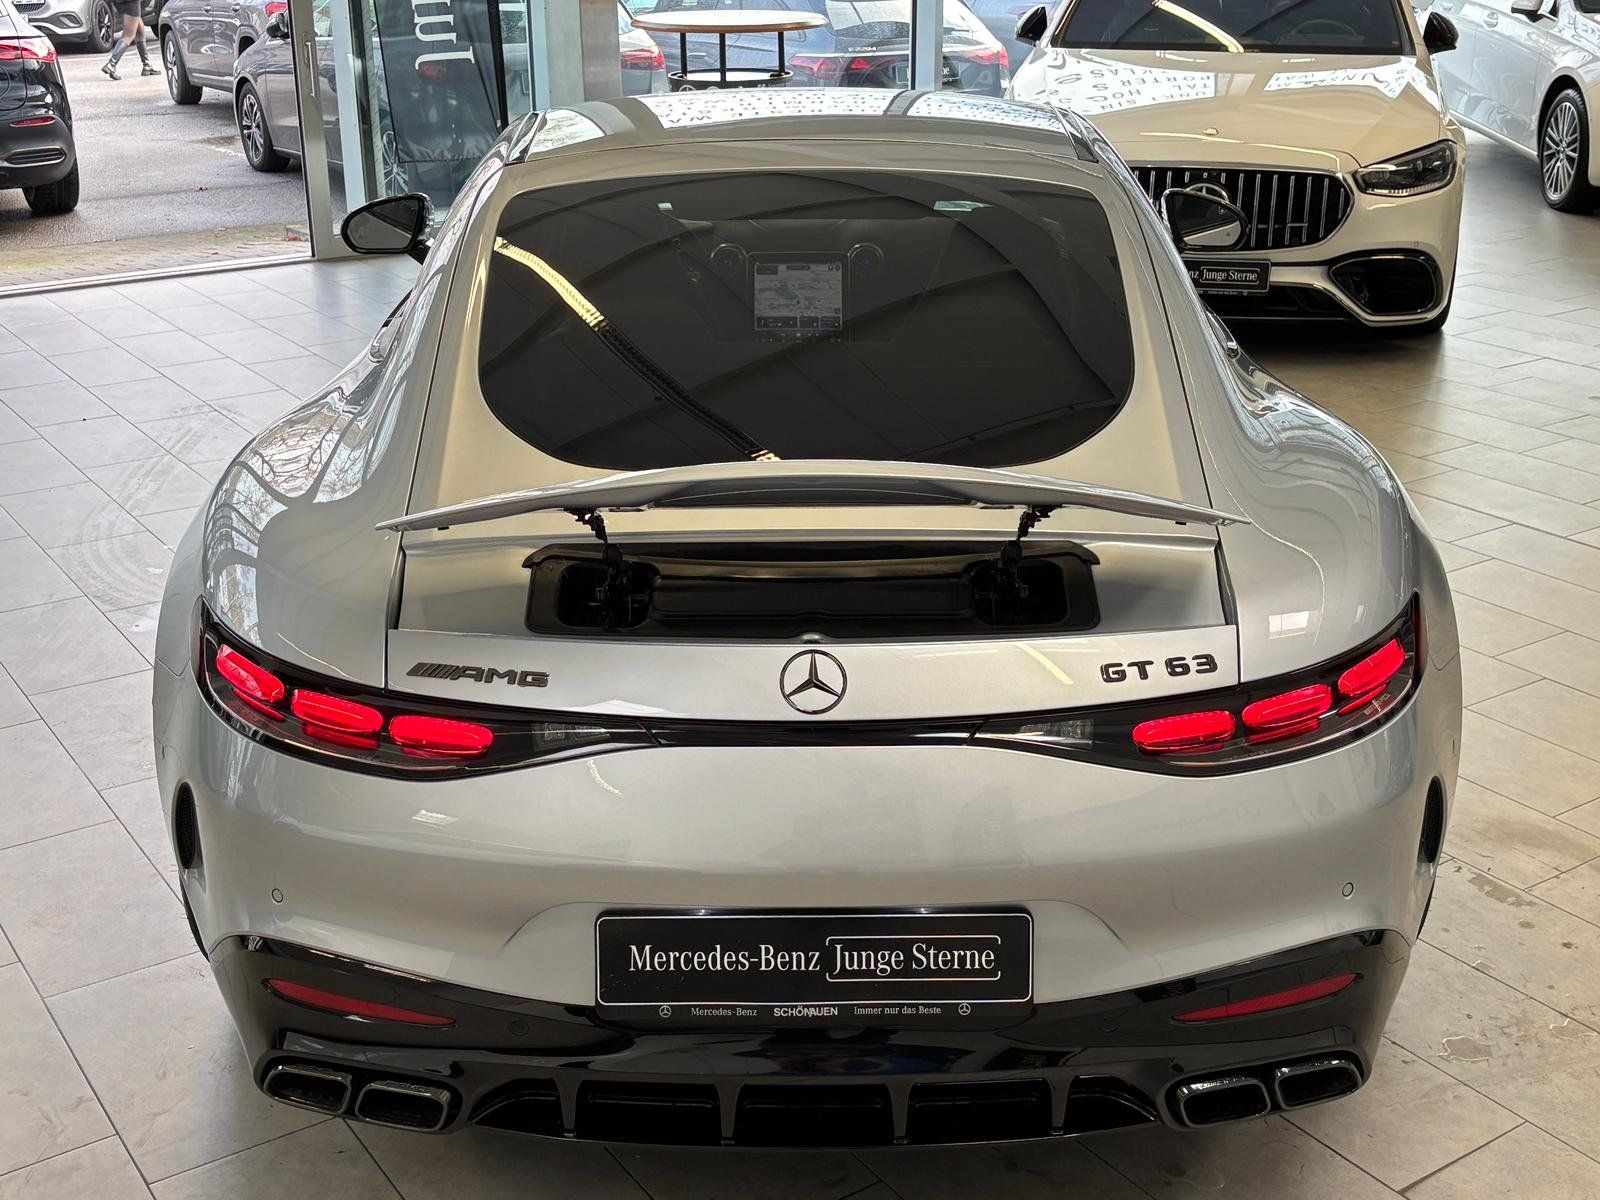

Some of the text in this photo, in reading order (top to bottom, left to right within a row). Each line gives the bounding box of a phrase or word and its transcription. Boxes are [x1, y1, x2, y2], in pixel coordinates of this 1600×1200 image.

[1202, 268, 1227, 282] Junge
[1228, 269, 1258, 281] Sterne
[450, 662, 550, 688] AMG
[1100, 653, 1219, 684] GT 63
[628, 942, 995, 977] Mercedes-Benz Junge Sterne
[690, 1005, 942, 1018] Mercedes-Benz SCHÖNAUEN Immer nur das Beste
